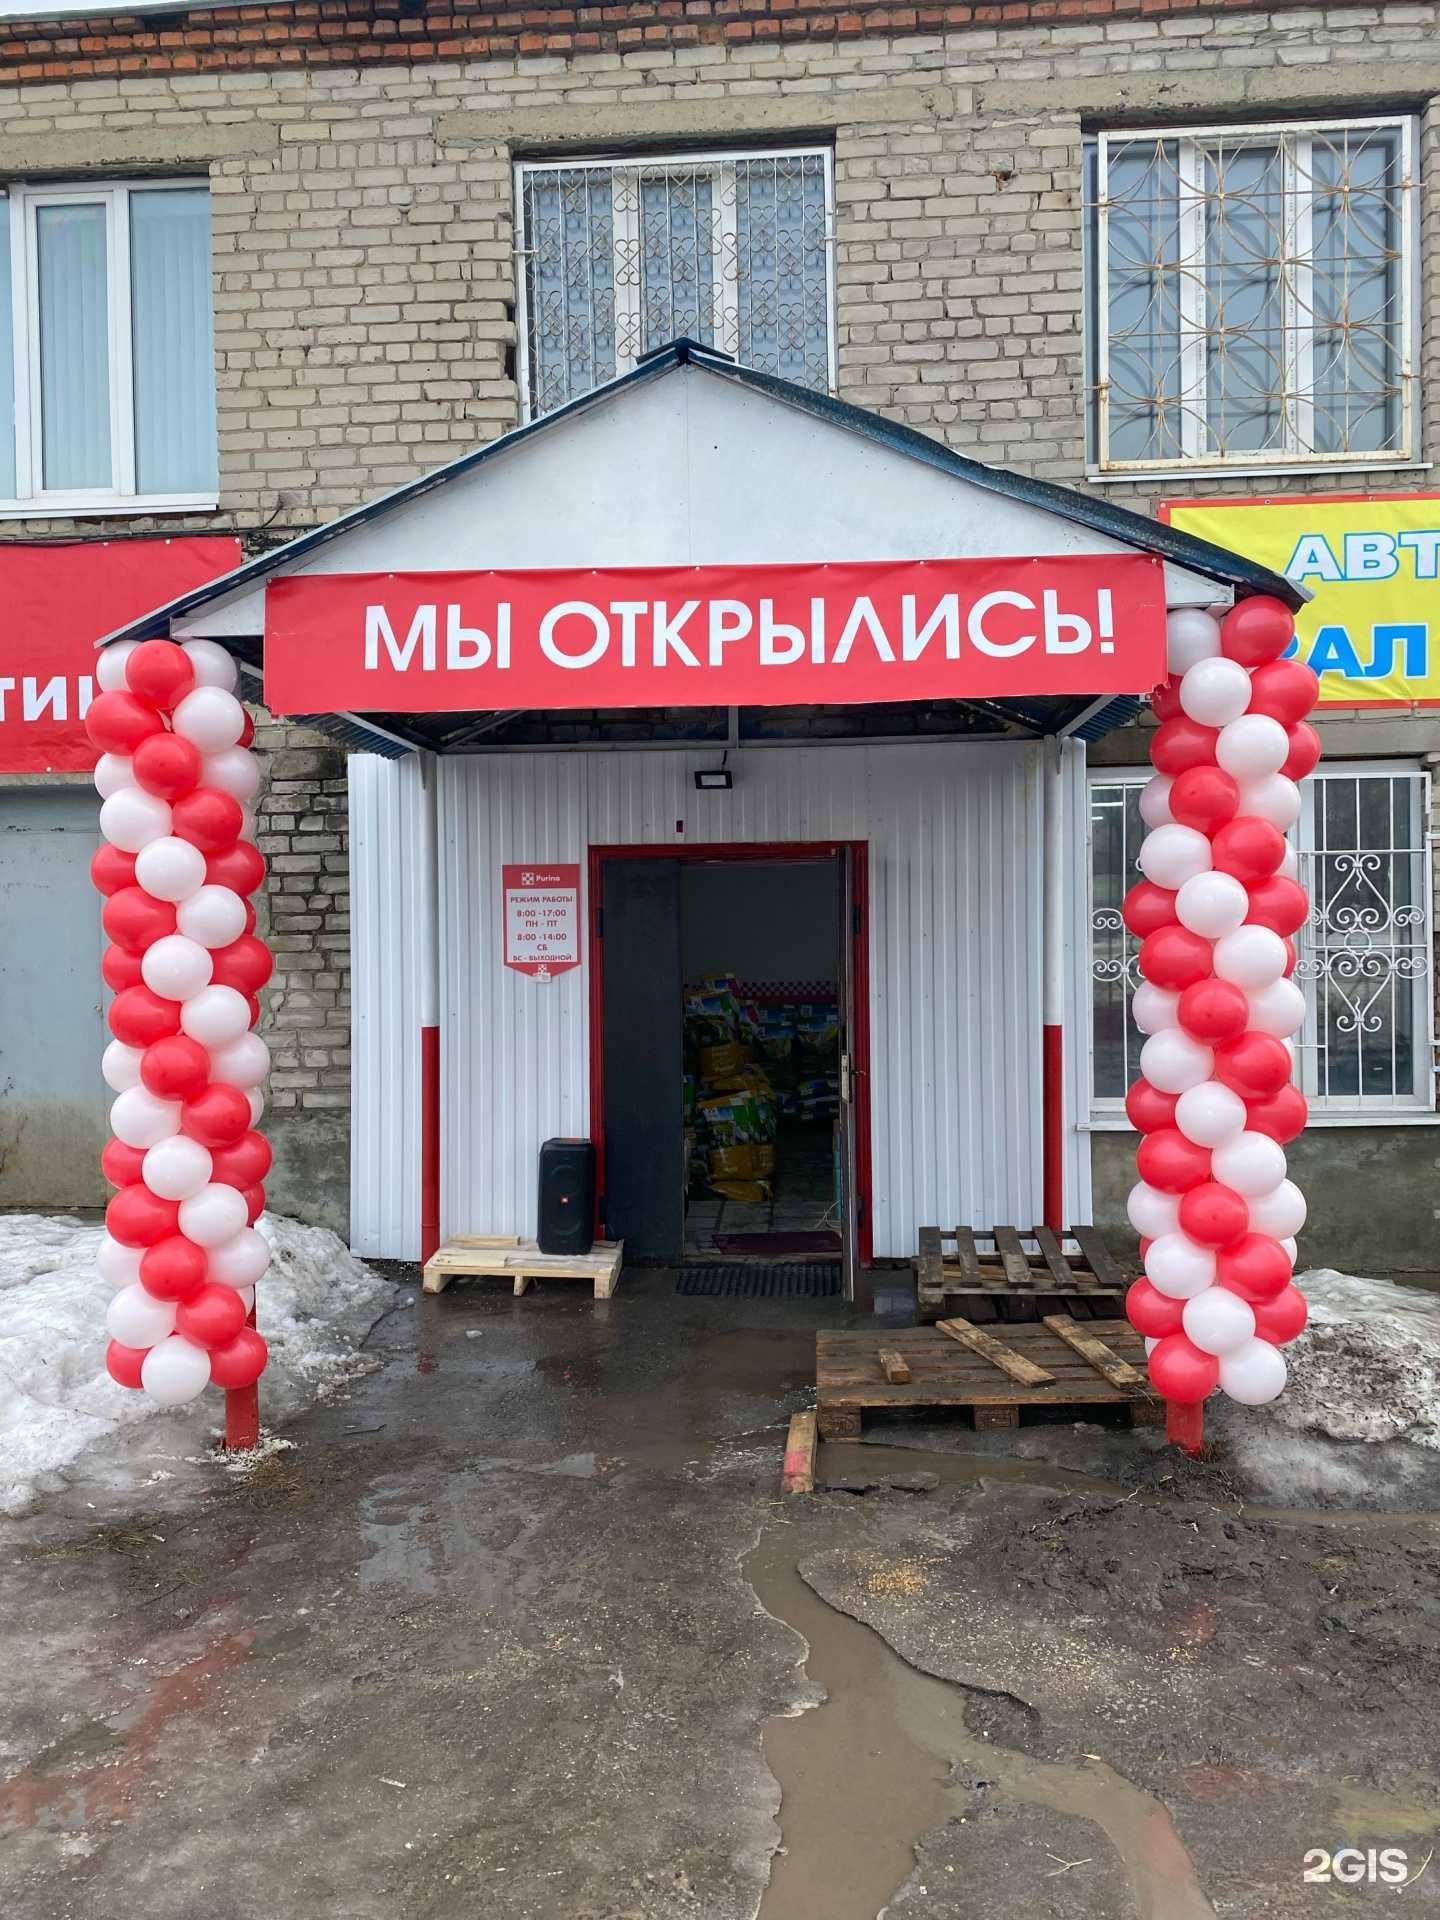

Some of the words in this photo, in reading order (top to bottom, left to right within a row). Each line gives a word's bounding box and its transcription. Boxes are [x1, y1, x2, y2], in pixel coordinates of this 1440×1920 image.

[365, 602, 511, 671] МЫ
[539, 589, 1114, 669] ОТКРЫЛИСЬ!
[1280, 623, 1428, 680] АЛ
[525, 920, 538, 928] ПН
[547, 920, 558, 928] ПТ
